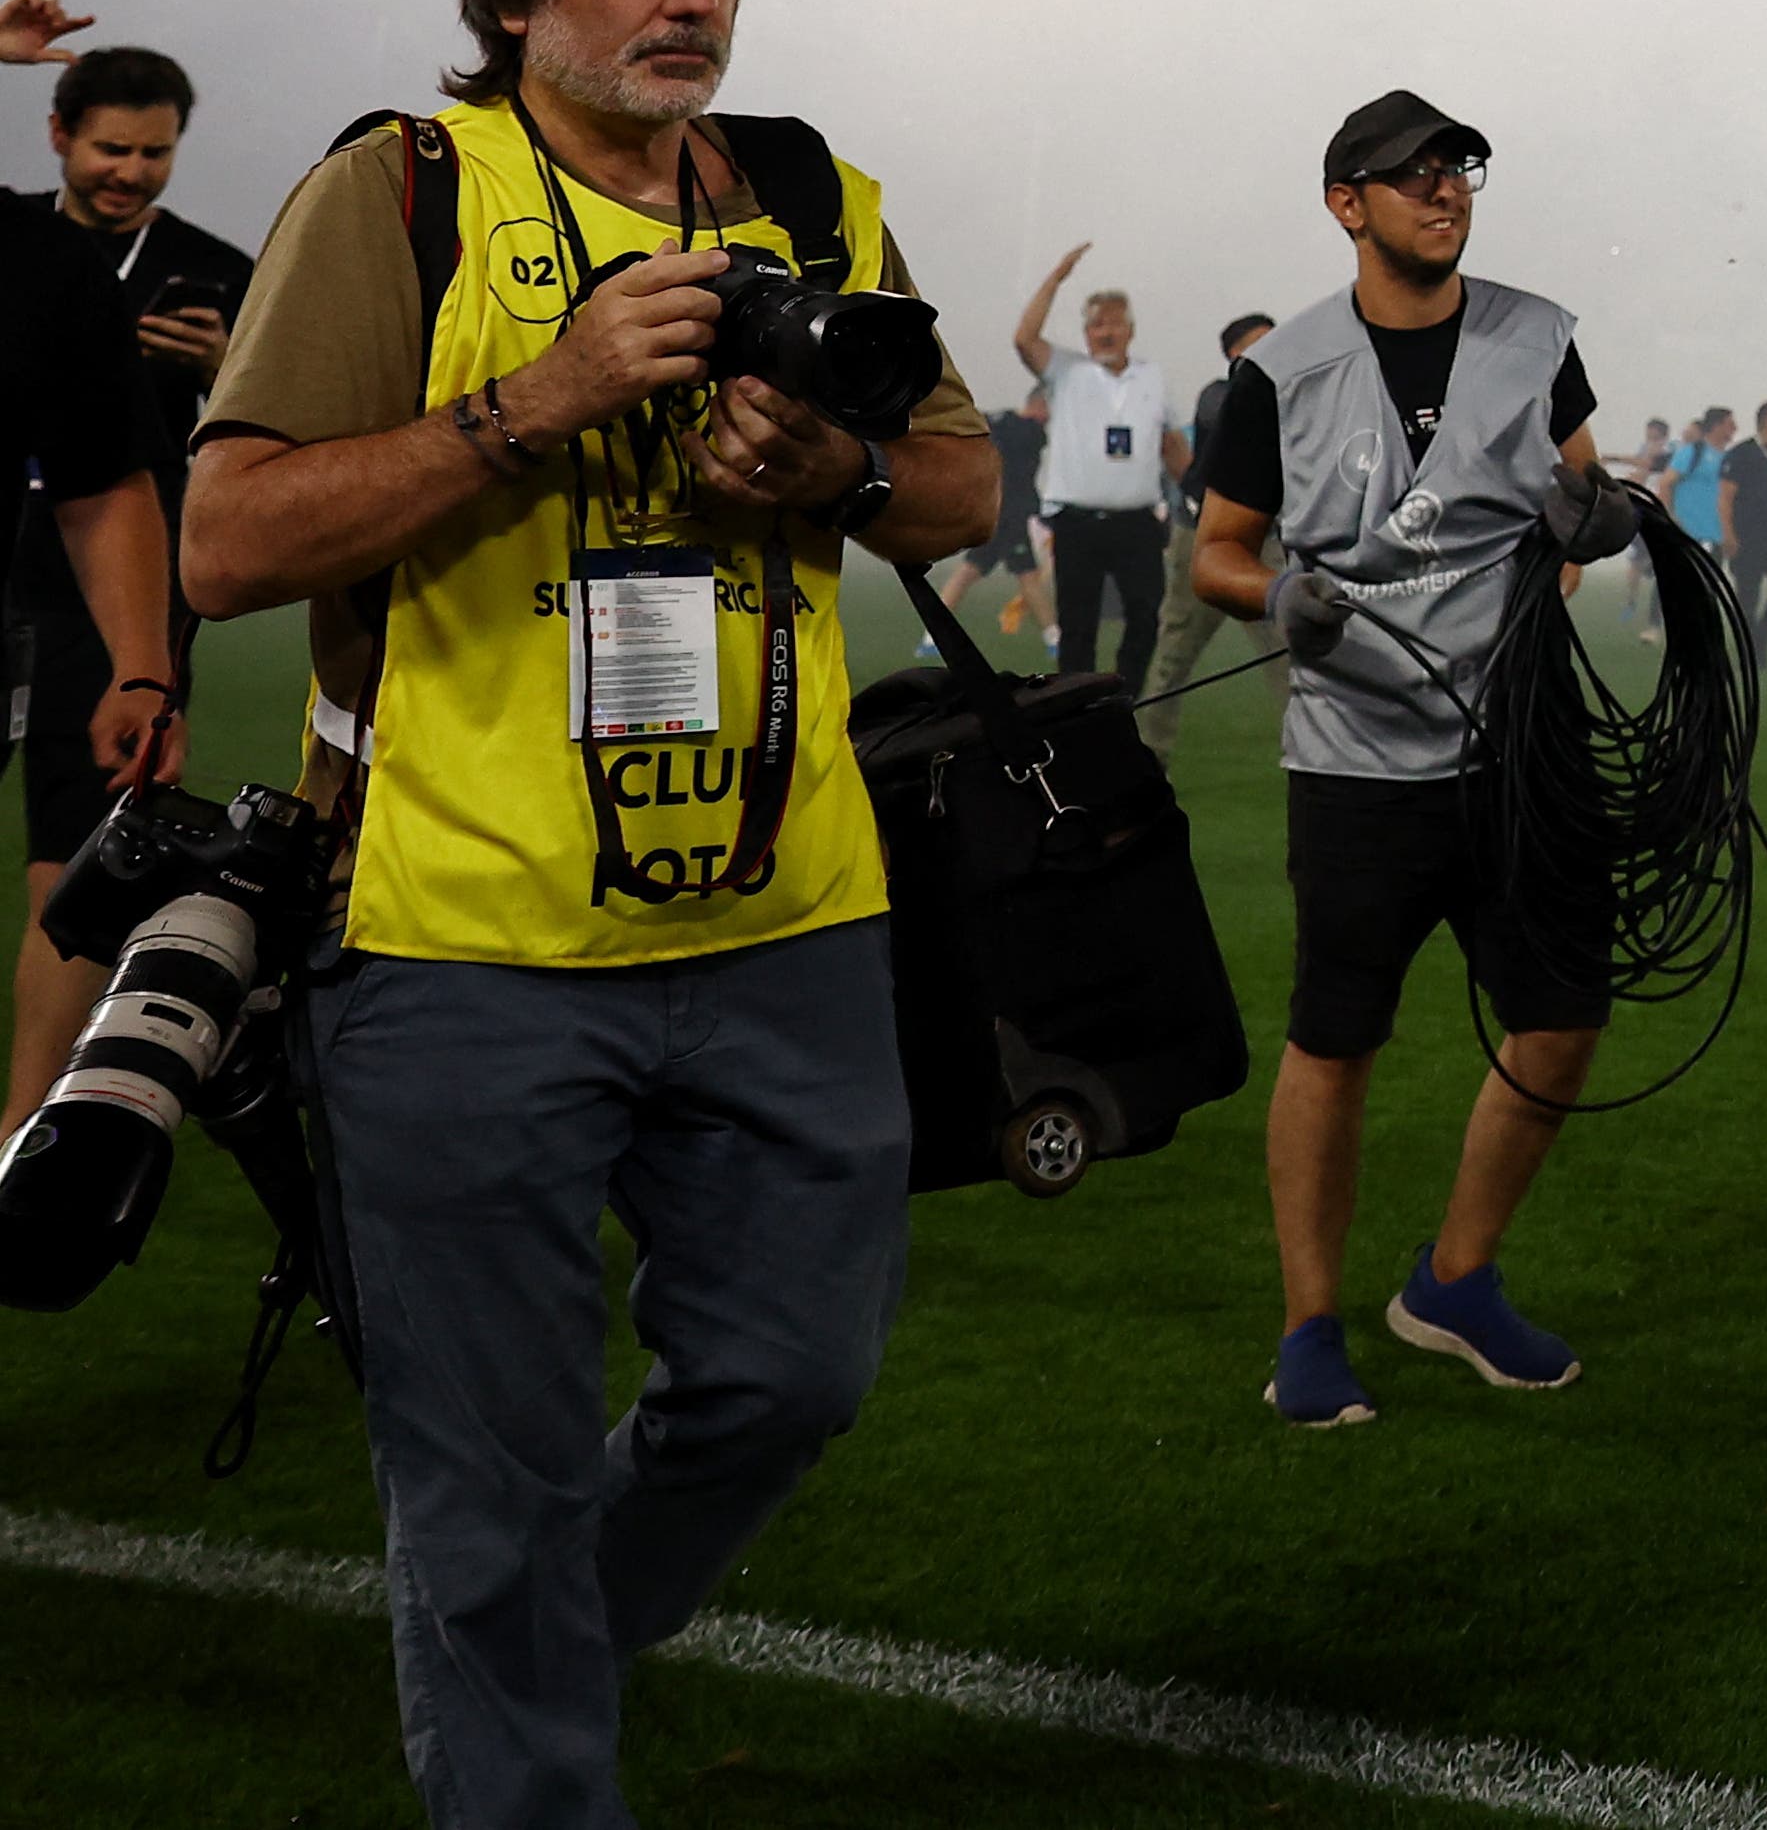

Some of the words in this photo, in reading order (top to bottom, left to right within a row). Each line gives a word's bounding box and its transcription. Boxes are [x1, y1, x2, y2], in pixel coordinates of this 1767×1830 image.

[511, 255, 557, 287] 02
[756, 264, 788, 276] Canon
[772, 628, 788, 682] EOS
[771, 685, 788, 713] R6
[766, 717, 782, 753] Mark
[219, 870, 264, 893] Canon
